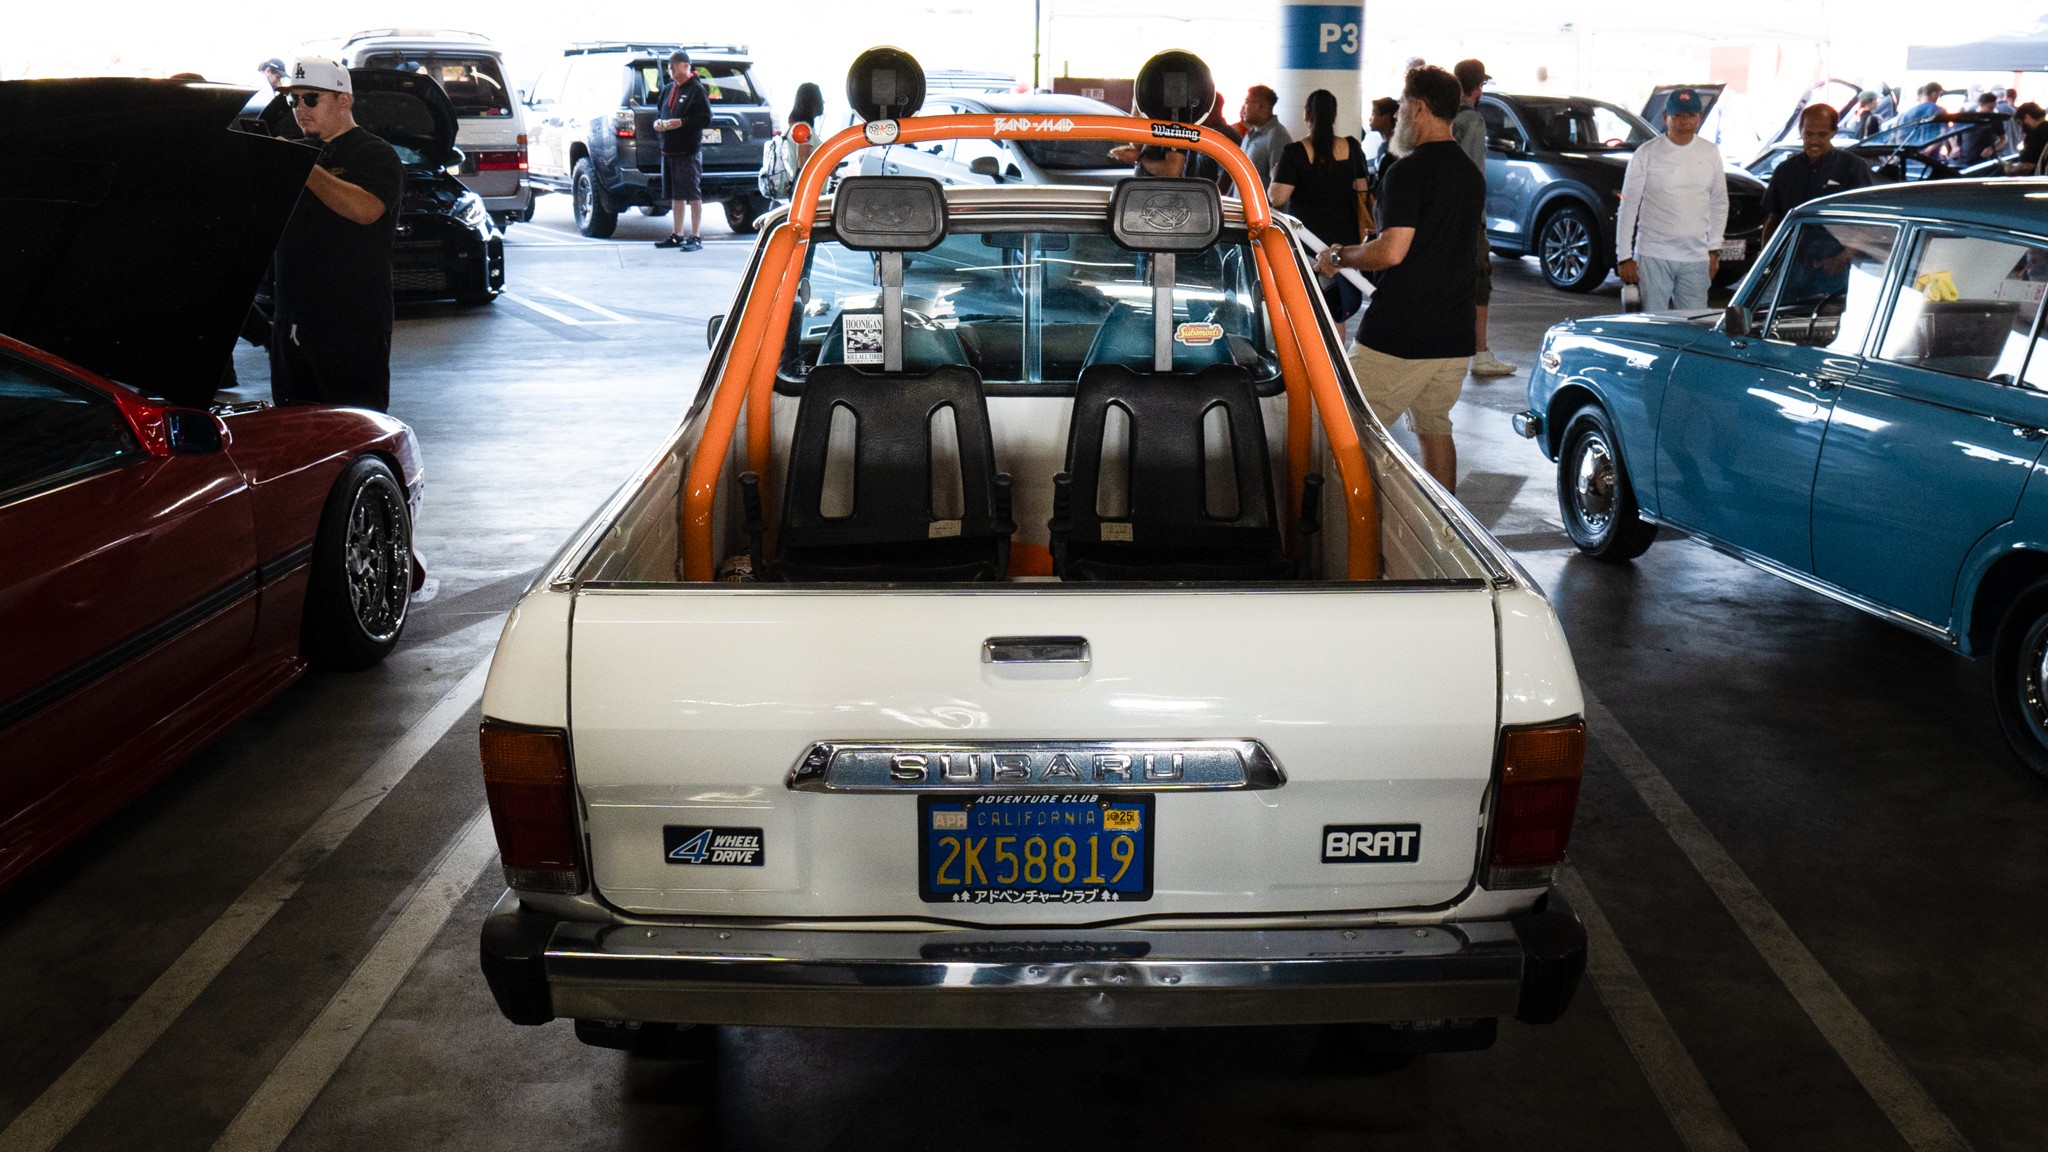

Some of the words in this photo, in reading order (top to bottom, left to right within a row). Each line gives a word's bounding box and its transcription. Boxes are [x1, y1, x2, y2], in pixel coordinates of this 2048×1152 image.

[1320, 23, 1358, 54] P3
[1152, 124, 1199, 141] Warning
[845, 319, 882, 329] HOONIGAN
[889, 753, 1185, 784] SUBARU
[975, 794, 1058, 804] ADVENTURE
[1061, 794, 1099, 803] CLUB
[934, 814, 967, 827] APR
[977, 810, 1096, 826] CALIFORNIA
[1119, 811, 1133, 822] 25
[669, 829, 714, 864] 4
[713, 835, 760, 848] WHEEL
[1325, 831, 1417, 857] BRAT
[711, 850, 755, 863] DRIVE
[936, 835, 1136, 886] 2K58819
[974, 889, 1100, 904] アドベンチャークラブ
